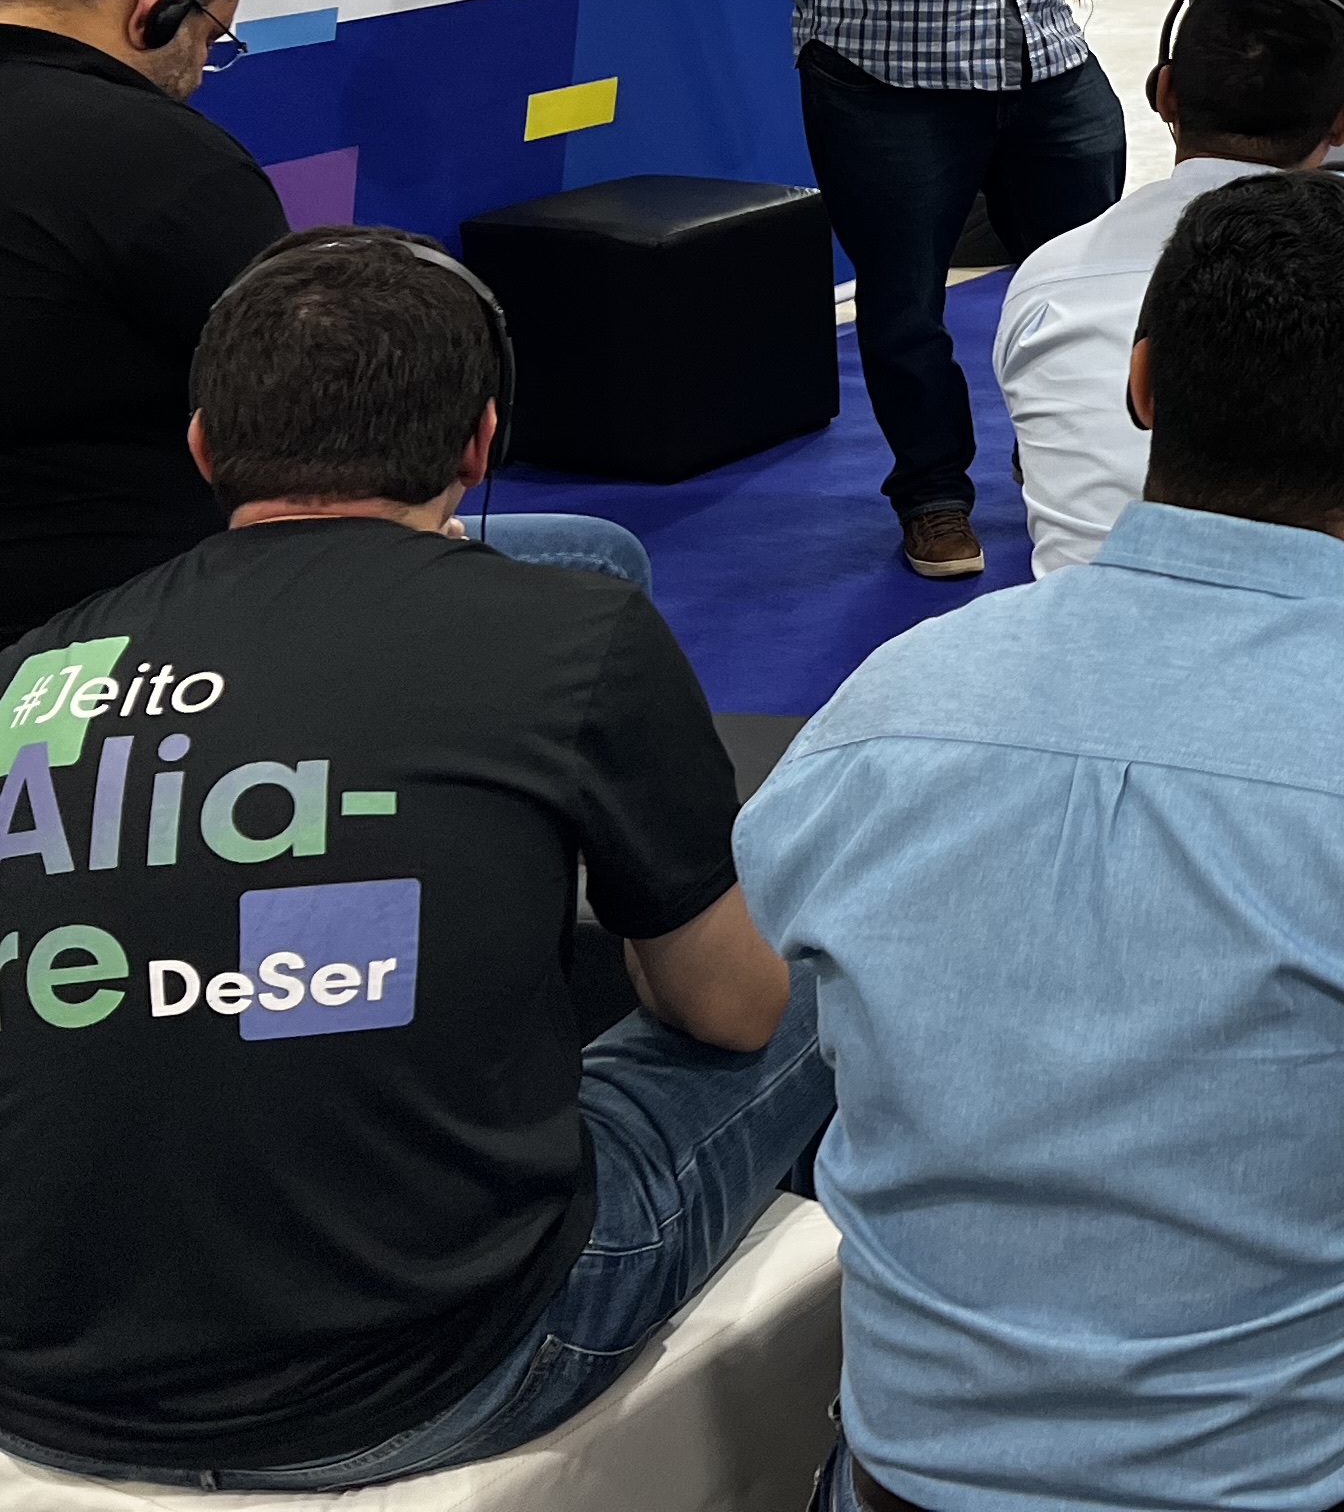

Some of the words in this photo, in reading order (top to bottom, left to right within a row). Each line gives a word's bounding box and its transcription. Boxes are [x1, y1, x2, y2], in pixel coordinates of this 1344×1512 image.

[10, 662, 225, 728] #Jeito
[0, 733, 397, 875] Alia-
[148, 951, 397, 1018] DeSer
